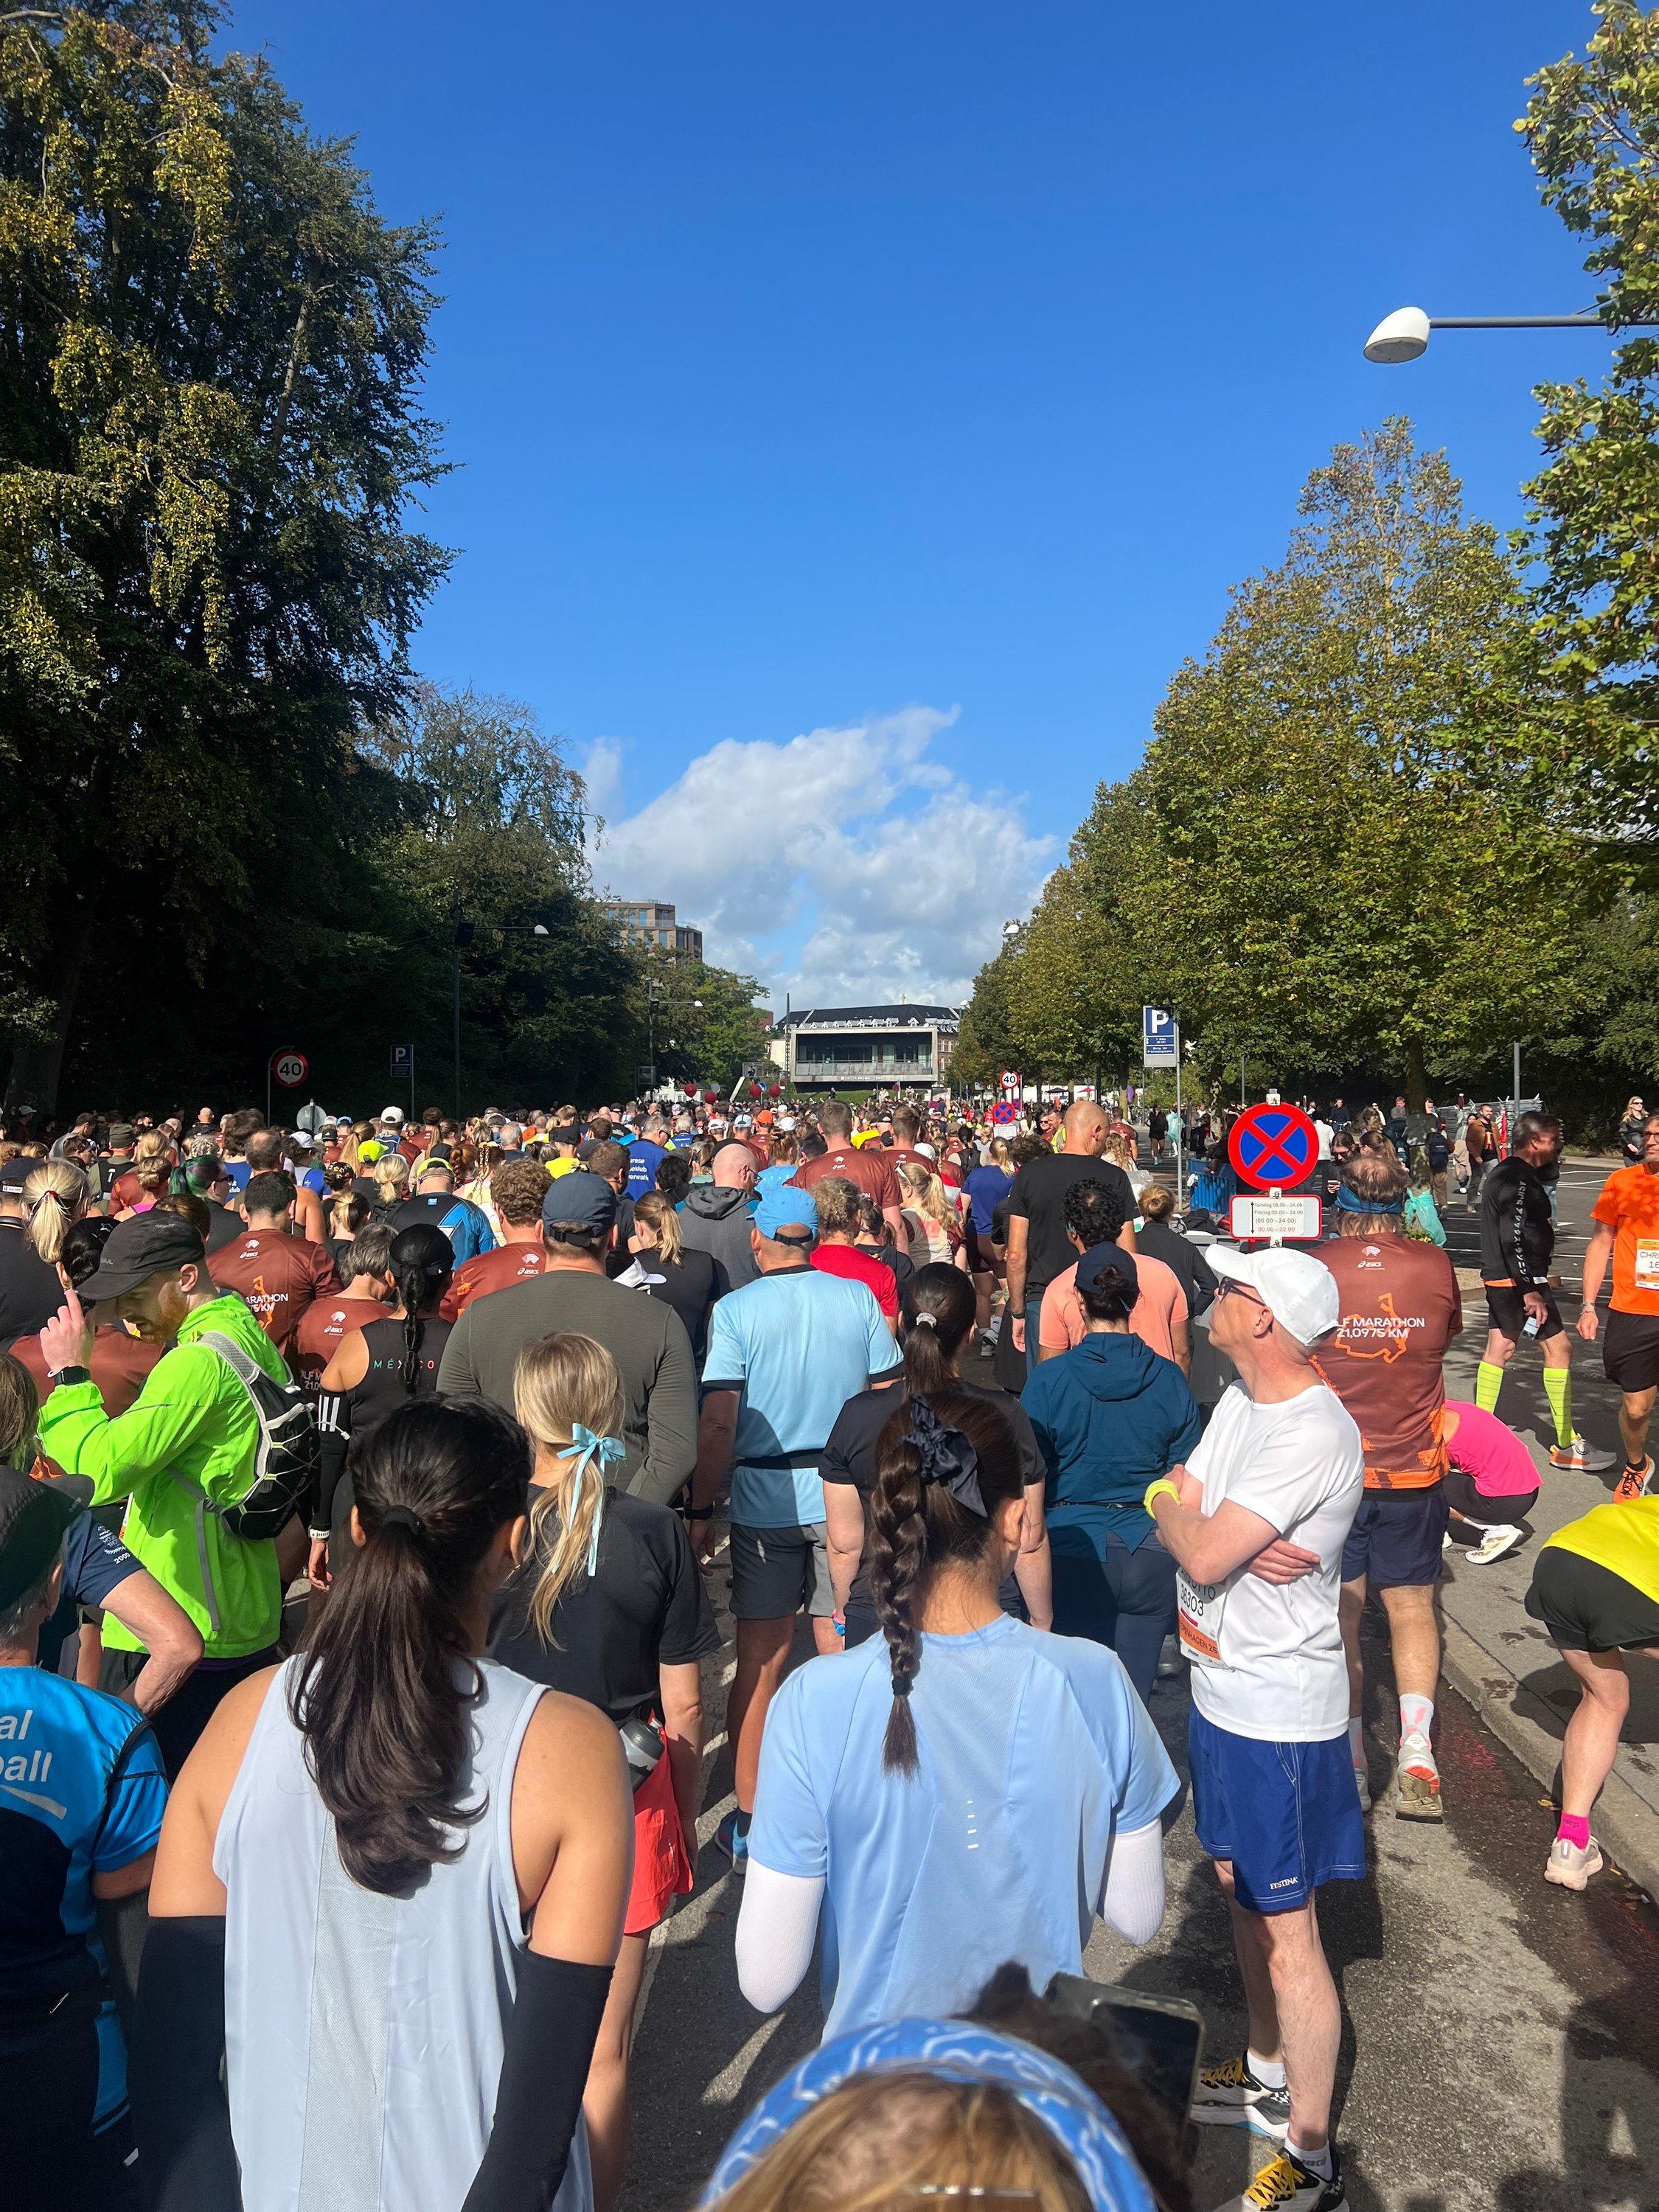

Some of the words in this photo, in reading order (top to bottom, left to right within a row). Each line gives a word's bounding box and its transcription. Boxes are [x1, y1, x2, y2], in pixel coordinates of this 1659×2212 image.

[1151, 1009, 1169, 1034] P
[395, 1047, 406, 1062] P
[279, 1062, 302, 1076] 40
[260, 1301, 276, 1312] KM
[1353, 1317, 1425, 1328] MARATHON
[1336, 1327, 1386, 1339] 21,0975
[1388, 1327, 1410, 1338] KM
[1180, 1583, 1204, 1616] 36303
[0, 1709, 33, 1740] al
[1269, 1876, 1298, 1890] FESTINA
